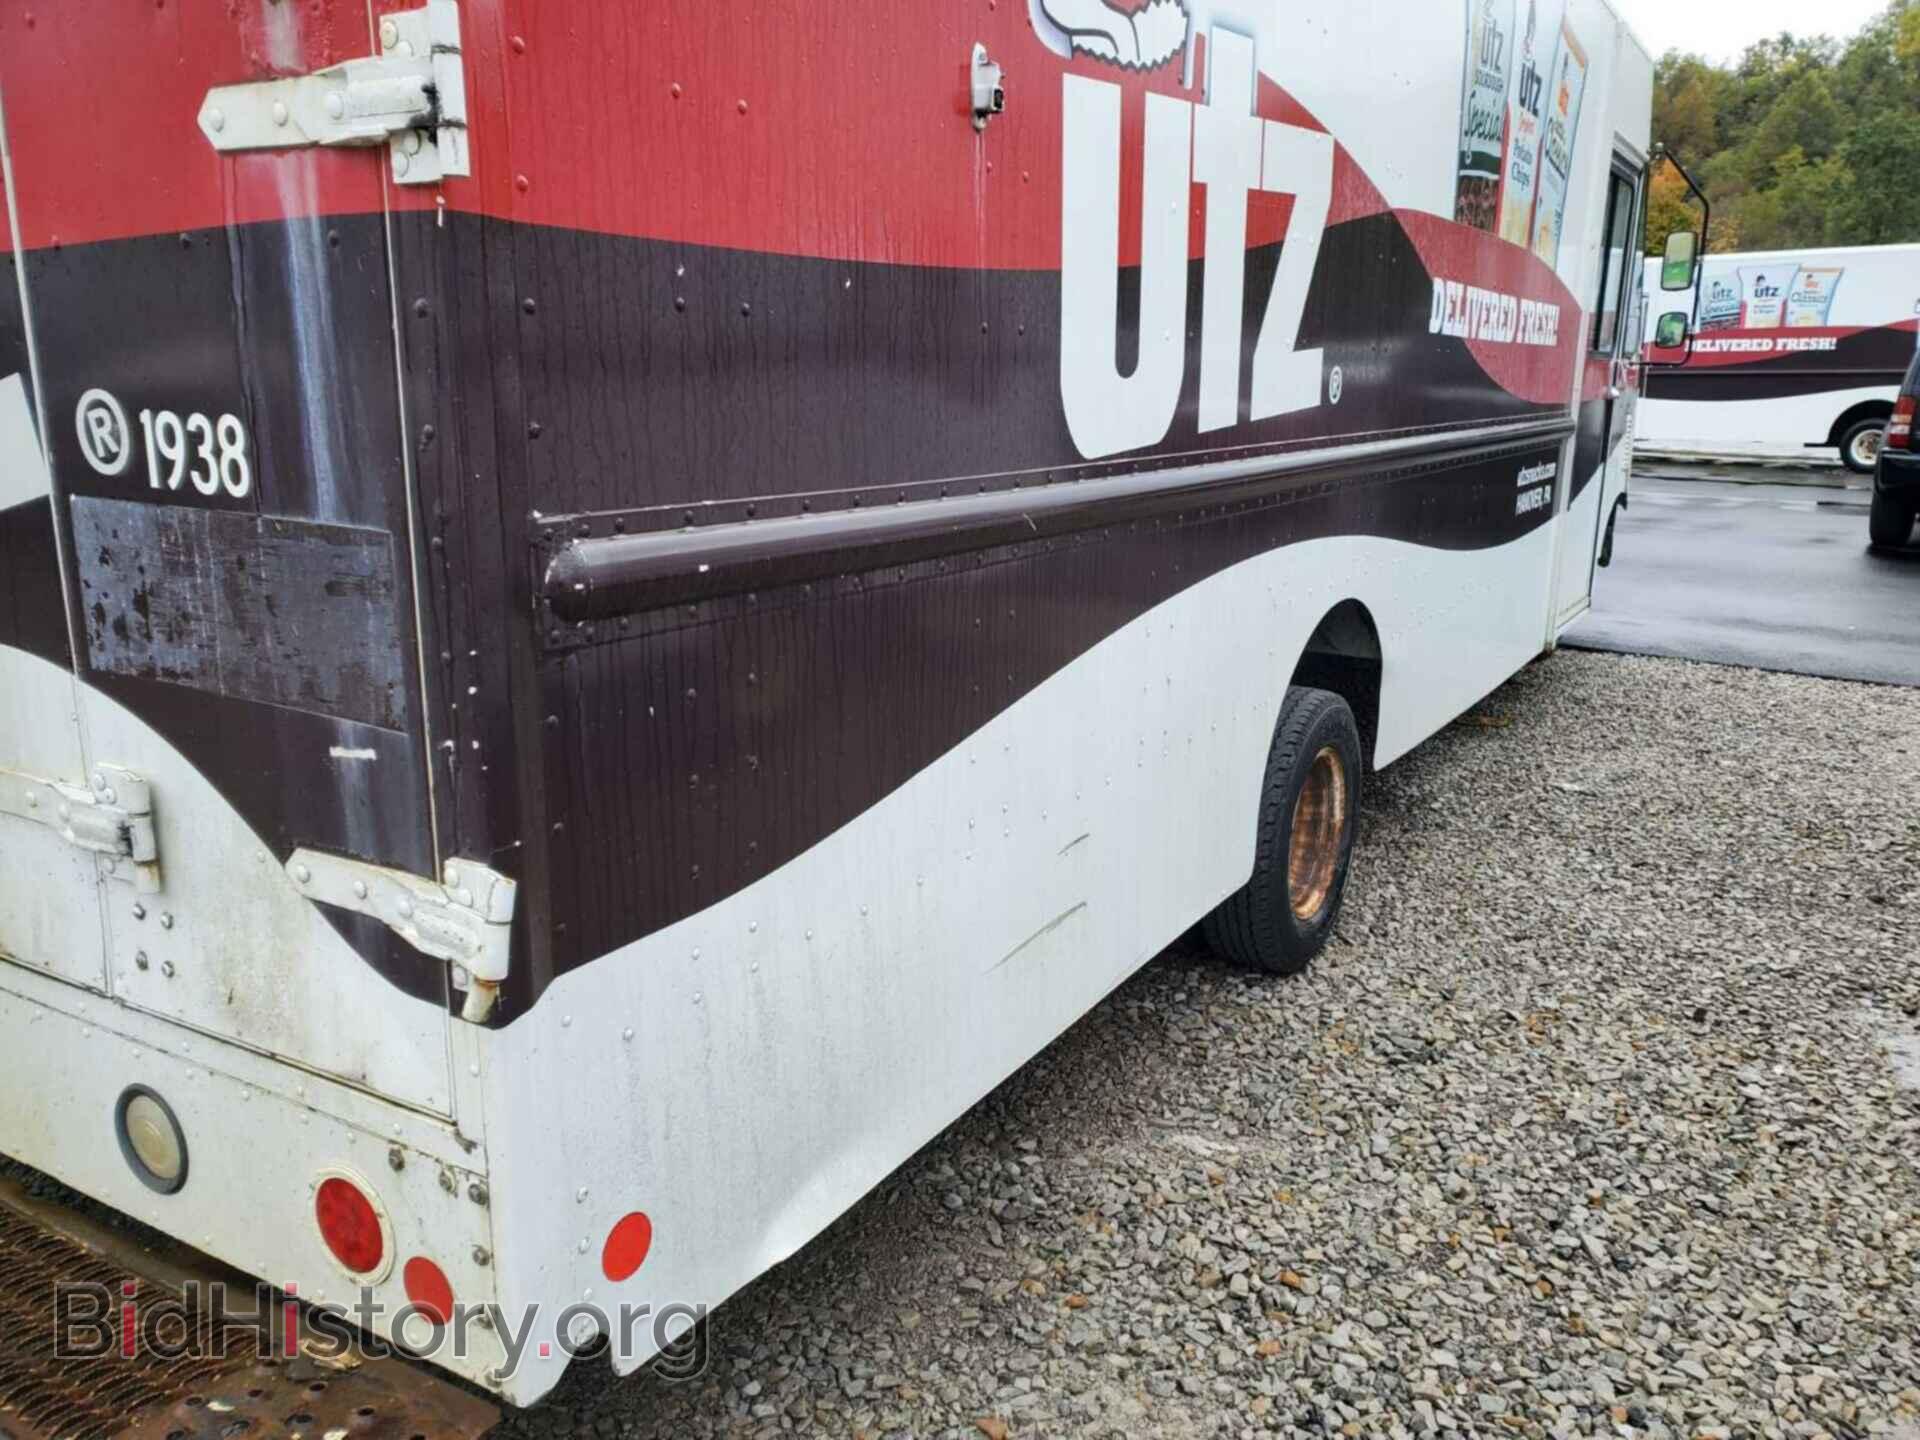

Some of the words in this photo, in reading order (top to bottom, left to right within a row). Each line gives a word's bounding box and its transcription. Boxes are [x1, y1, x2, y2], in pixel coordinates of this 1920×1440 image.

[1428, 276, 1517, 344] DELIVERED
[1516, 298, 1560, 346] FRESH!
[1754, 286, 1780, 298] utz
[1776, 336, 1838, 351] FRESH!
[139, 408, 251, 498] 1938
